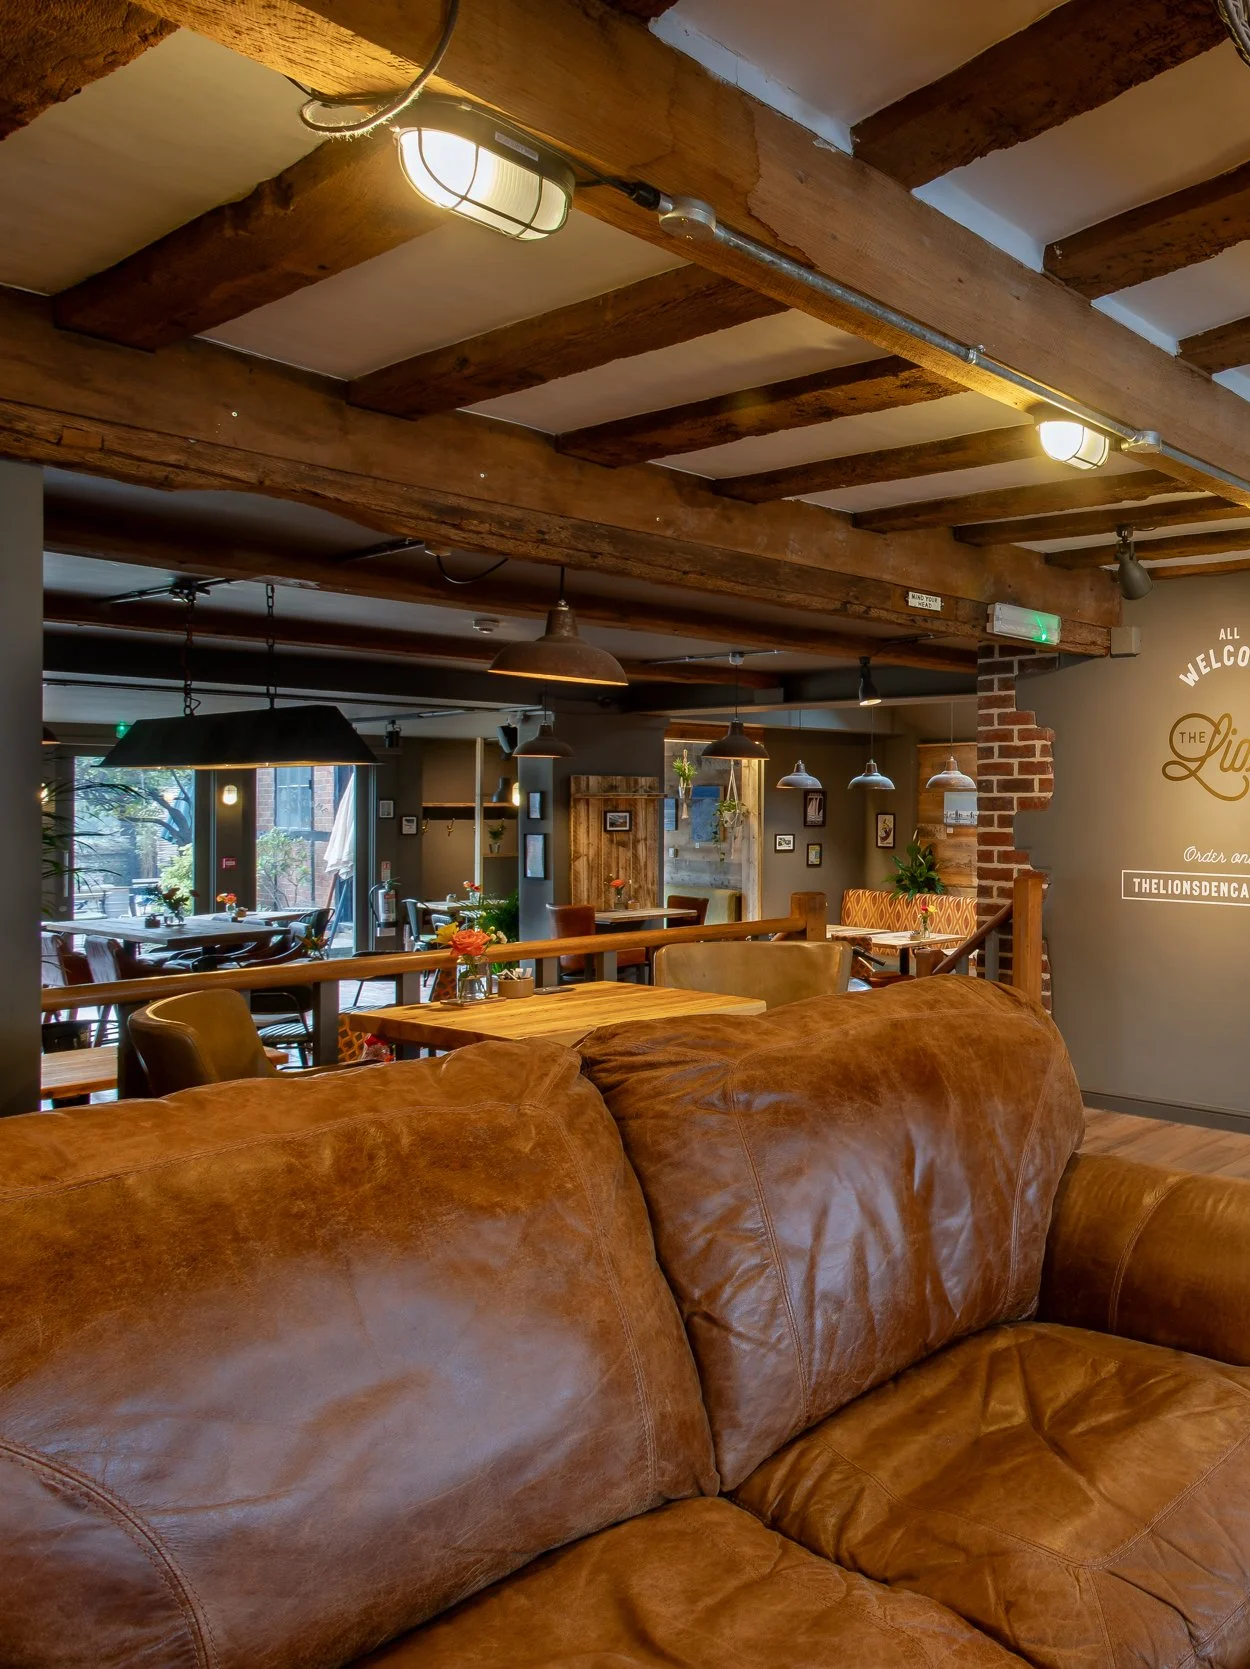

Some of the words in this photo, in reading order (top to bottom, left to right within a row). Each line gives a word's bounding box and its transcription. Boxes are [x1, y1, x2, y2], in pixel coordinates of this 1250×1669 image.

[911, 593, 924, 602] MIND
[918, 601, 932, 609] HEAD
[1219, 627, 1240, 640] ALL
[1179, 732, 1206, 743] THE
[1183, 846, 1226, 864] Order
